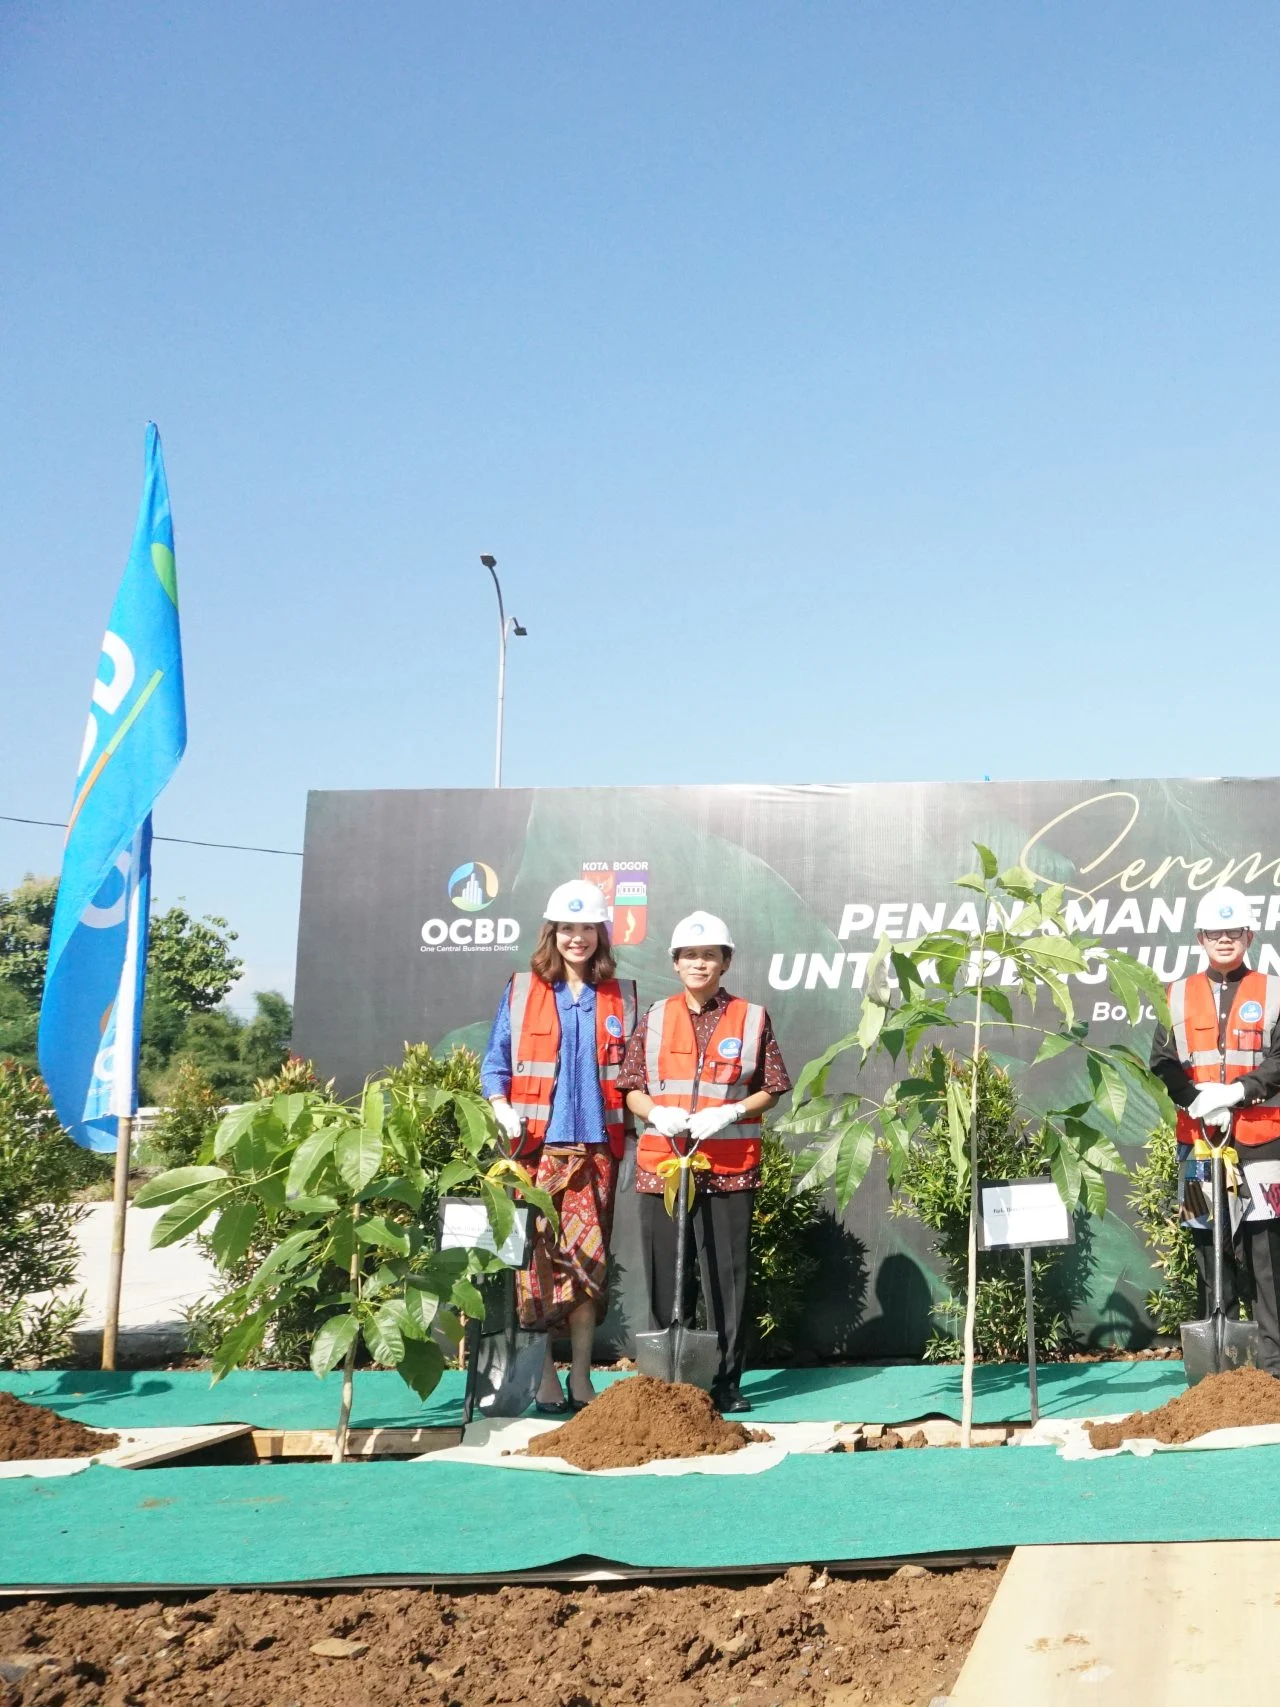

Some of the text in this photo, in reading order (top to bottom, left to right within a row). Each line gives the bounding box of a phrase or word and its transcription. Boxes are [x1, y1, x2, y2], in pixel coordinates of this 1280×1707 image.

[582, 861, 648, 871] KOTA BOGOR
[421, 918, 520, 946] OCBD
[493, 944, 518, 952] District
